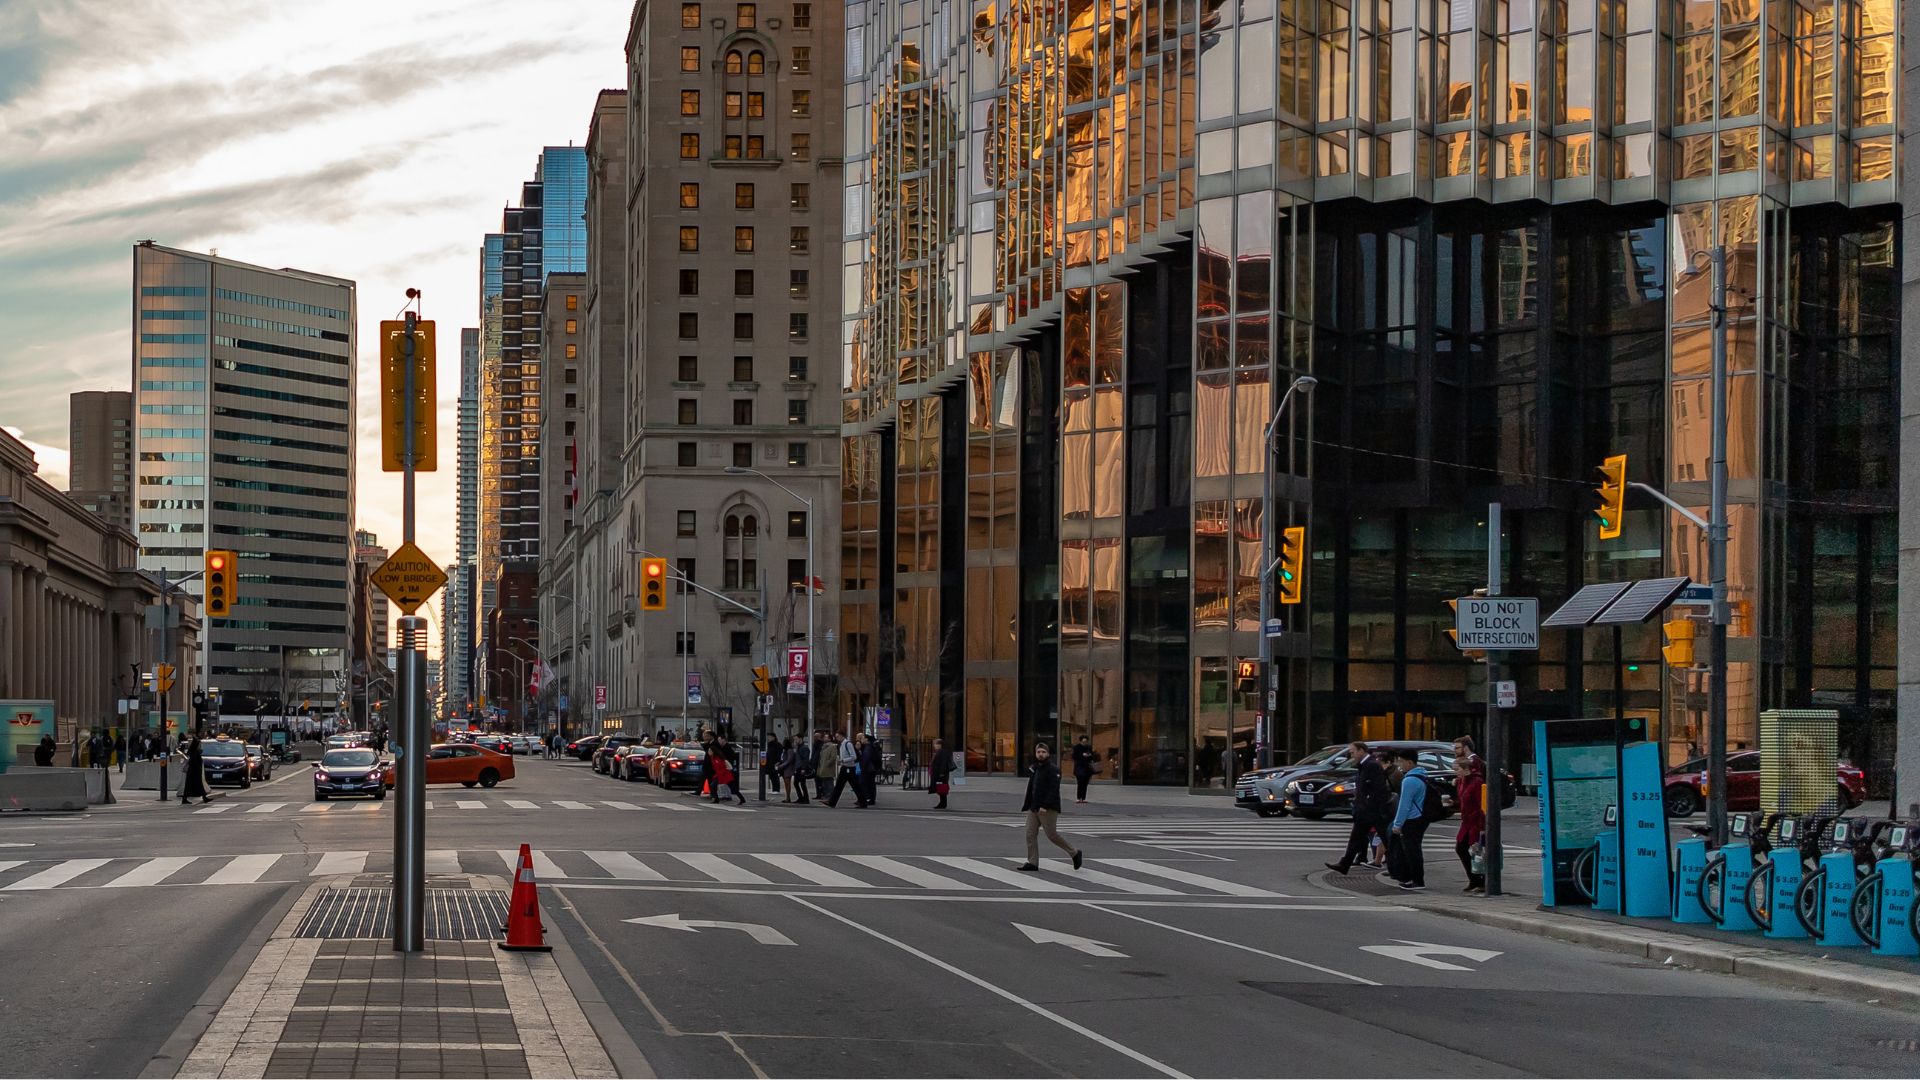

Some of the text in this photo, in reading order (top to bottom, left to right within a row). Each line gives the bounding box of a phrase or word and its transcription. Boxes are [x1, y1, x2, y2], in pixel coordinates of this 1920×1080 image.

[387, 562, 430, 572] CAUTION
[1471, 602, 1524, 614] DO NOT
[1474, 618, 1520, 629] BLOCK
[1461, 632, 1535, 644] INTERSECTION
[794, 654, 803, 668] 9
[1638, 820, 1655, 829] One
[1637, 848, 1656, 858] Way
[1887, 917, 1904, 927] Way
